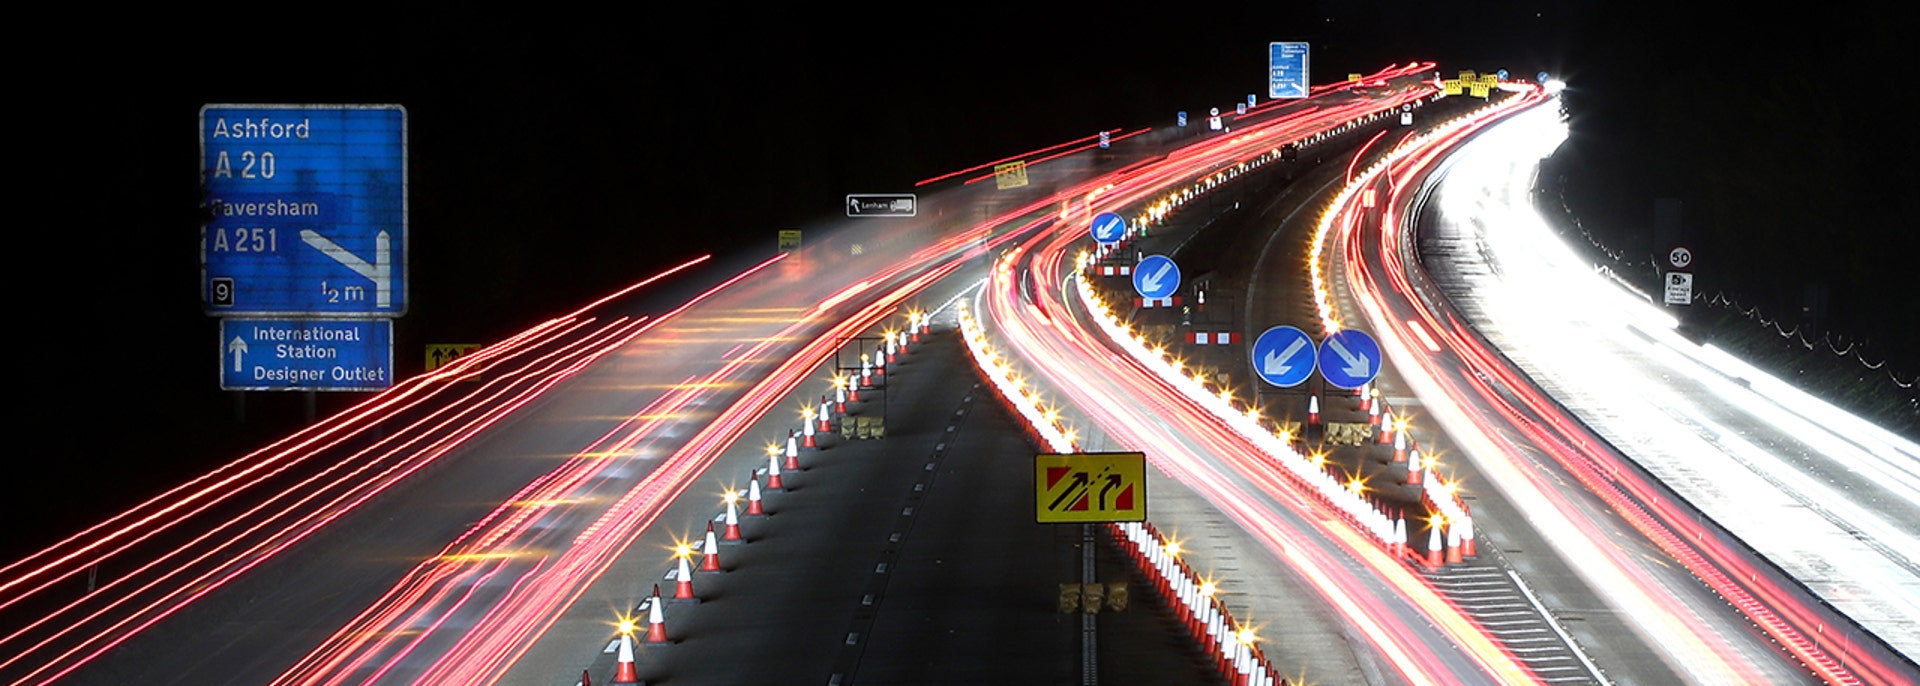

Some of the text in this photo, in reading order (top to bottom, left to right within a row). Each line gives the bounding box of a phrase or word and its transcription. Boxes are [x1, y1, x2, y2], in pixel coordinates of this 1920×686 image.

[213, 118, 310, 138] Ashford
[1672, 252, 1690, 263] 50
[217, 284, 229, 301] 9
[344, 285, 364, 301] m
[254, 327, 360, 341] International
[276, 345, 336, 359] Station
[254, 366, 384, 383] Designer Outlet
